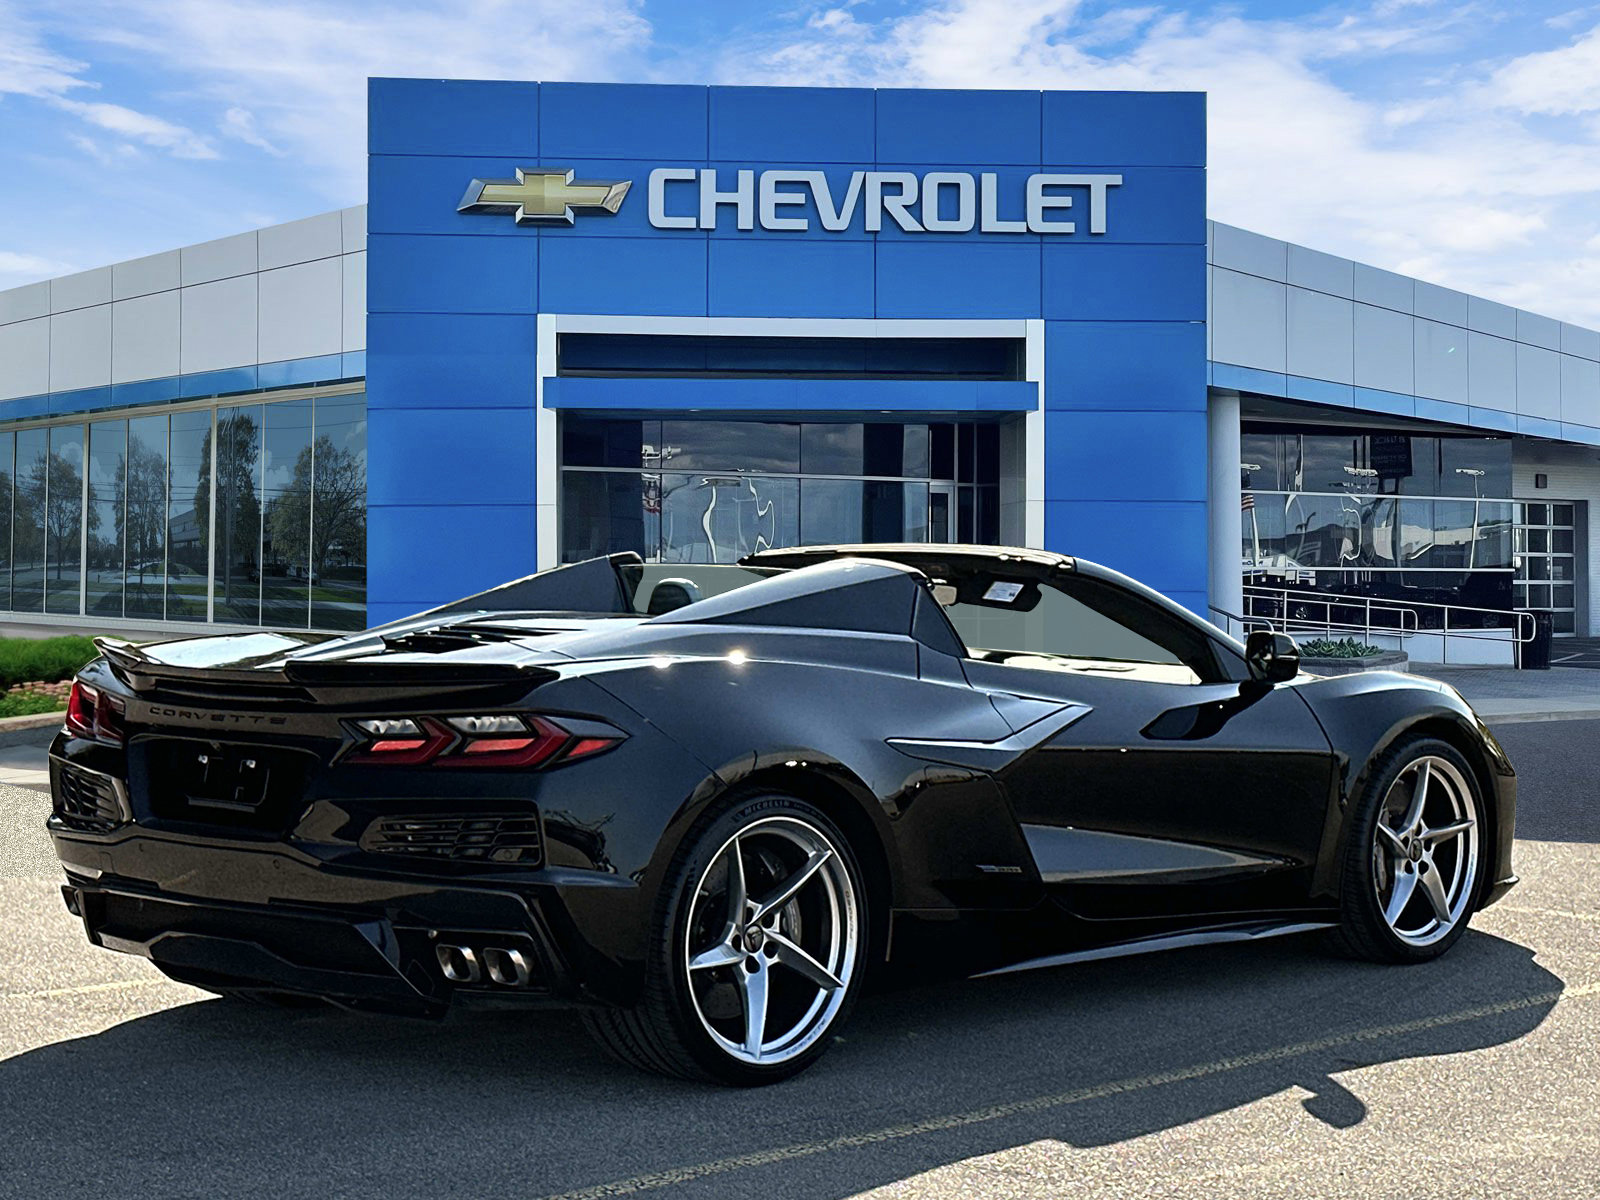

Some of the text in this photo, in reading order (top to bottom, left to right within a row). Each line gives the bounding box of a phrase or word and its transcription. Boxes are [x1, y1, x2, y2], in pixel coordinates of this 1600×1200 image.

[647, 168, 1123, 234] CHEVROLET
[149, 706, 287, 725] CORVETTE
[744, 800, 790, 815] MICHELIN
